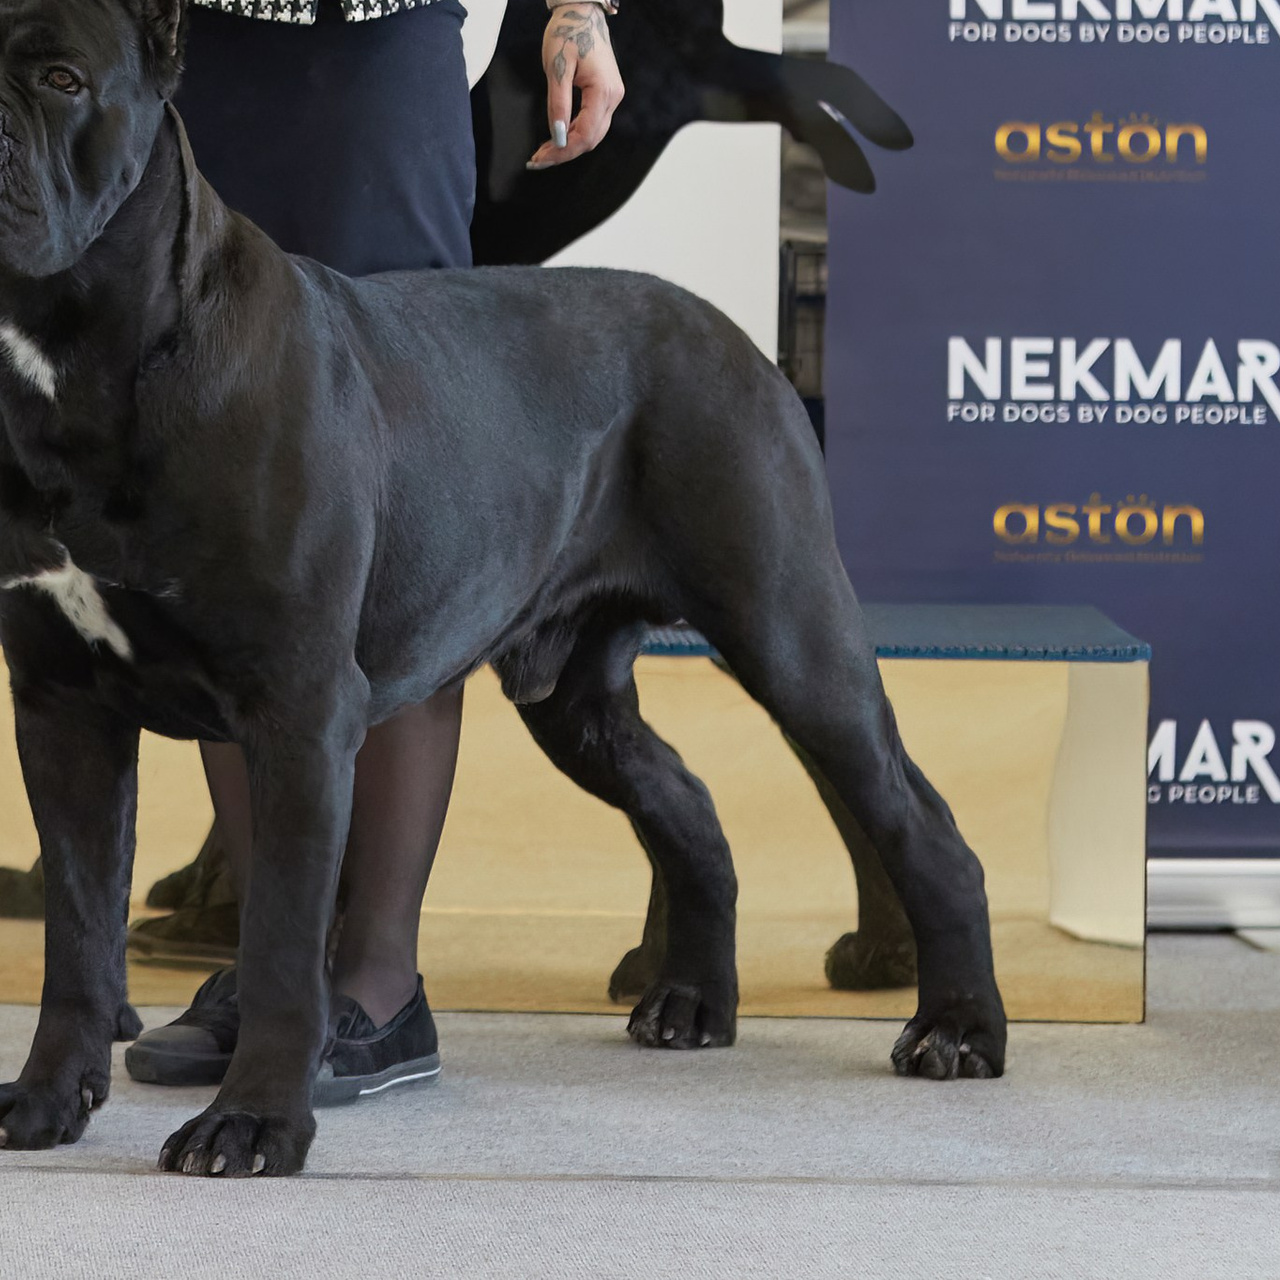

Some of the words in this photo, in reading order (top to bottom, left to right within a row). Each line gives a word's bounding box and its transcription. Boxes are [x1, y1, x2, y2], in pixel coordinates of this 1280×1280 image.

[949, 24, 997, 43] FOR
[1005, 24, 1072, 43] DOGS
[1080, 24, 1110, 43] BY
[1118, 24, 1170, 44] DOG
[1178, 24, 1270, 44] PEOPLE
[946, 336, 1280, 425] NEKMAR
[948, 403, 996, 423] FOR
[1003, 403, 1071, 423] DOGS
[1078, 404, 1109, 424] BY
[1116, 404, 1168, 425] DOG
[1175, 404, 1267, 425] PEOPLE
[1168, 784, 1261, 804] PEOPLE
